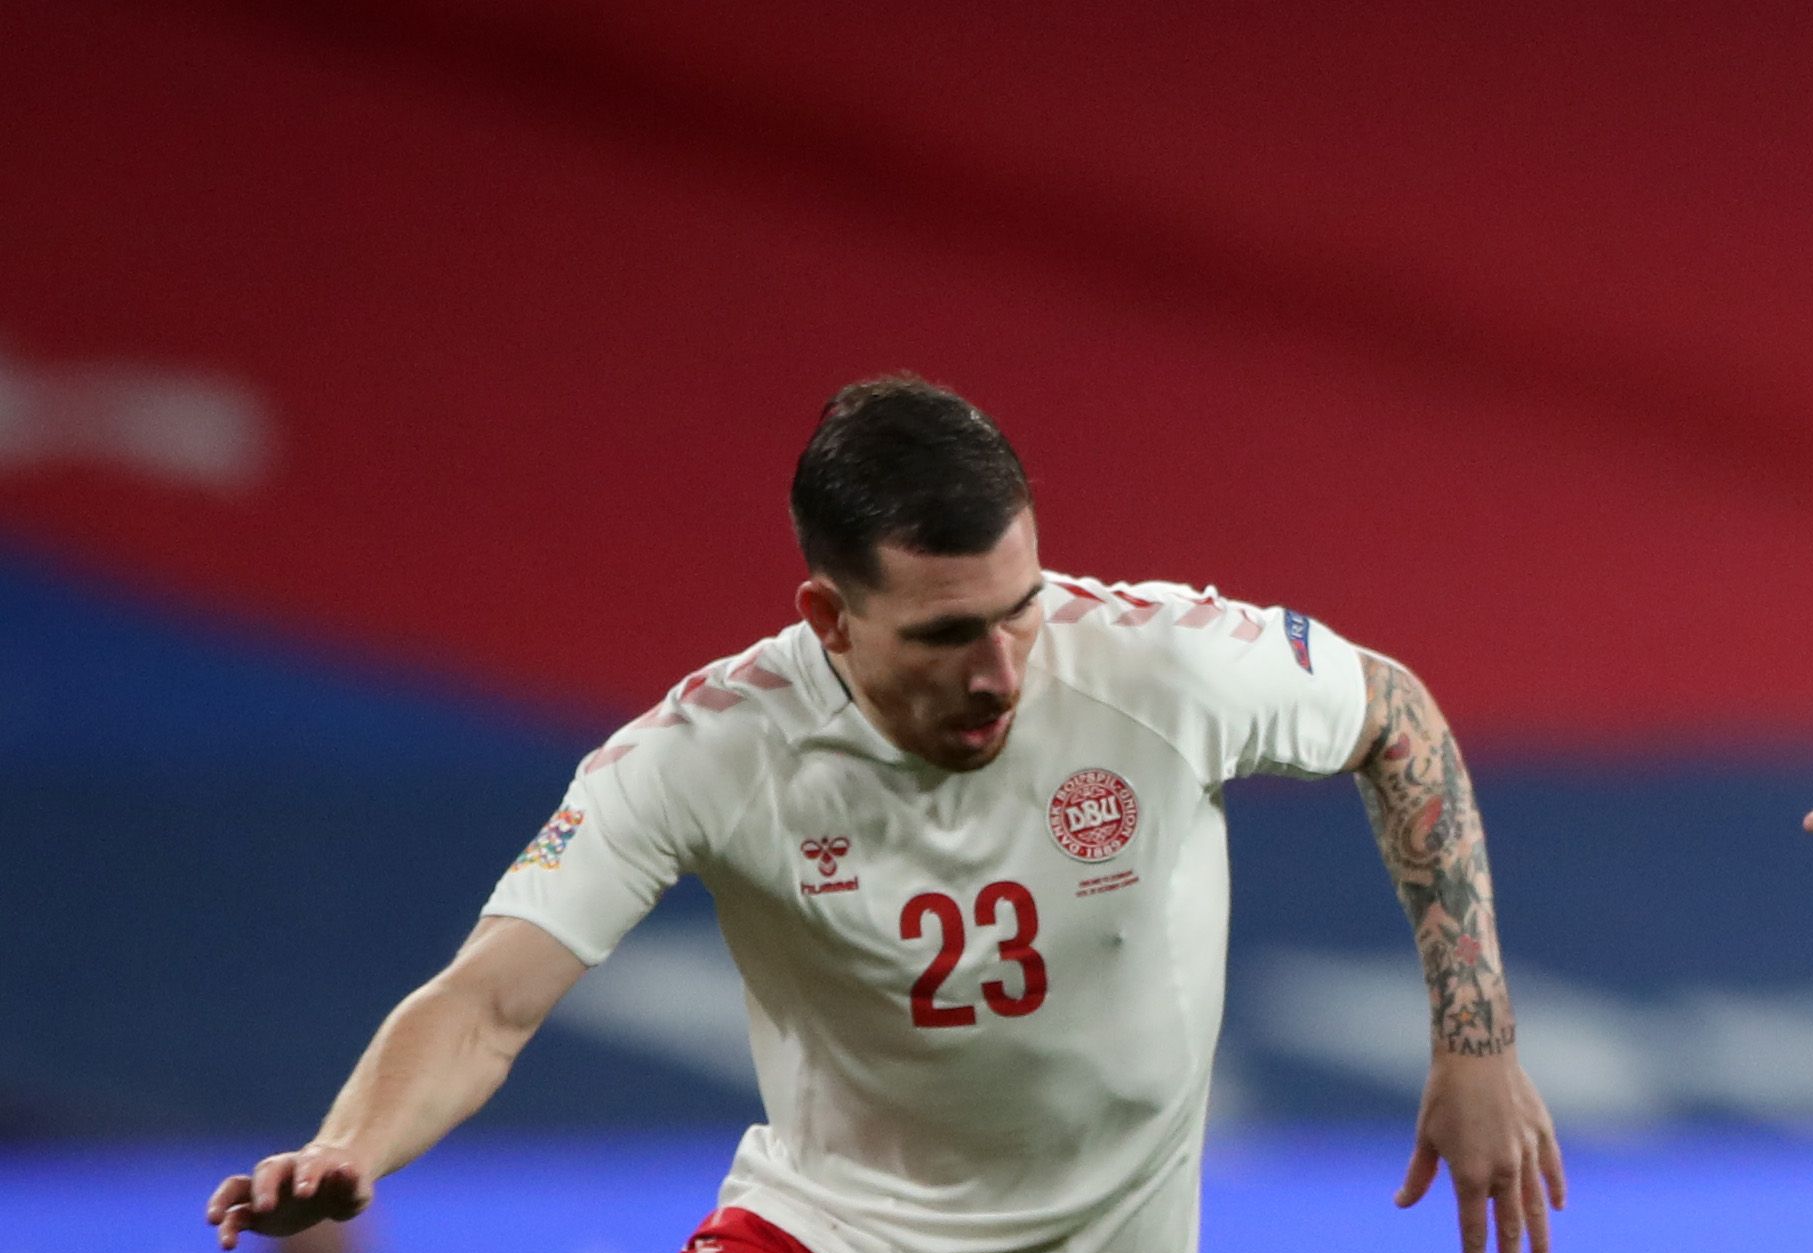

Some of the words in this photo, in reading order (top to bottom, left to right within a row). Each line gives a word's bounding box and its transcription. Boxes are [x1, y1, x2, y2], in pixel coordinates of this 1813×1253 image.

[1065, 795, 1121, 833] DBU
[800, 876, 859, 896] hummel
[899, 880, 1048, 1028] 23
